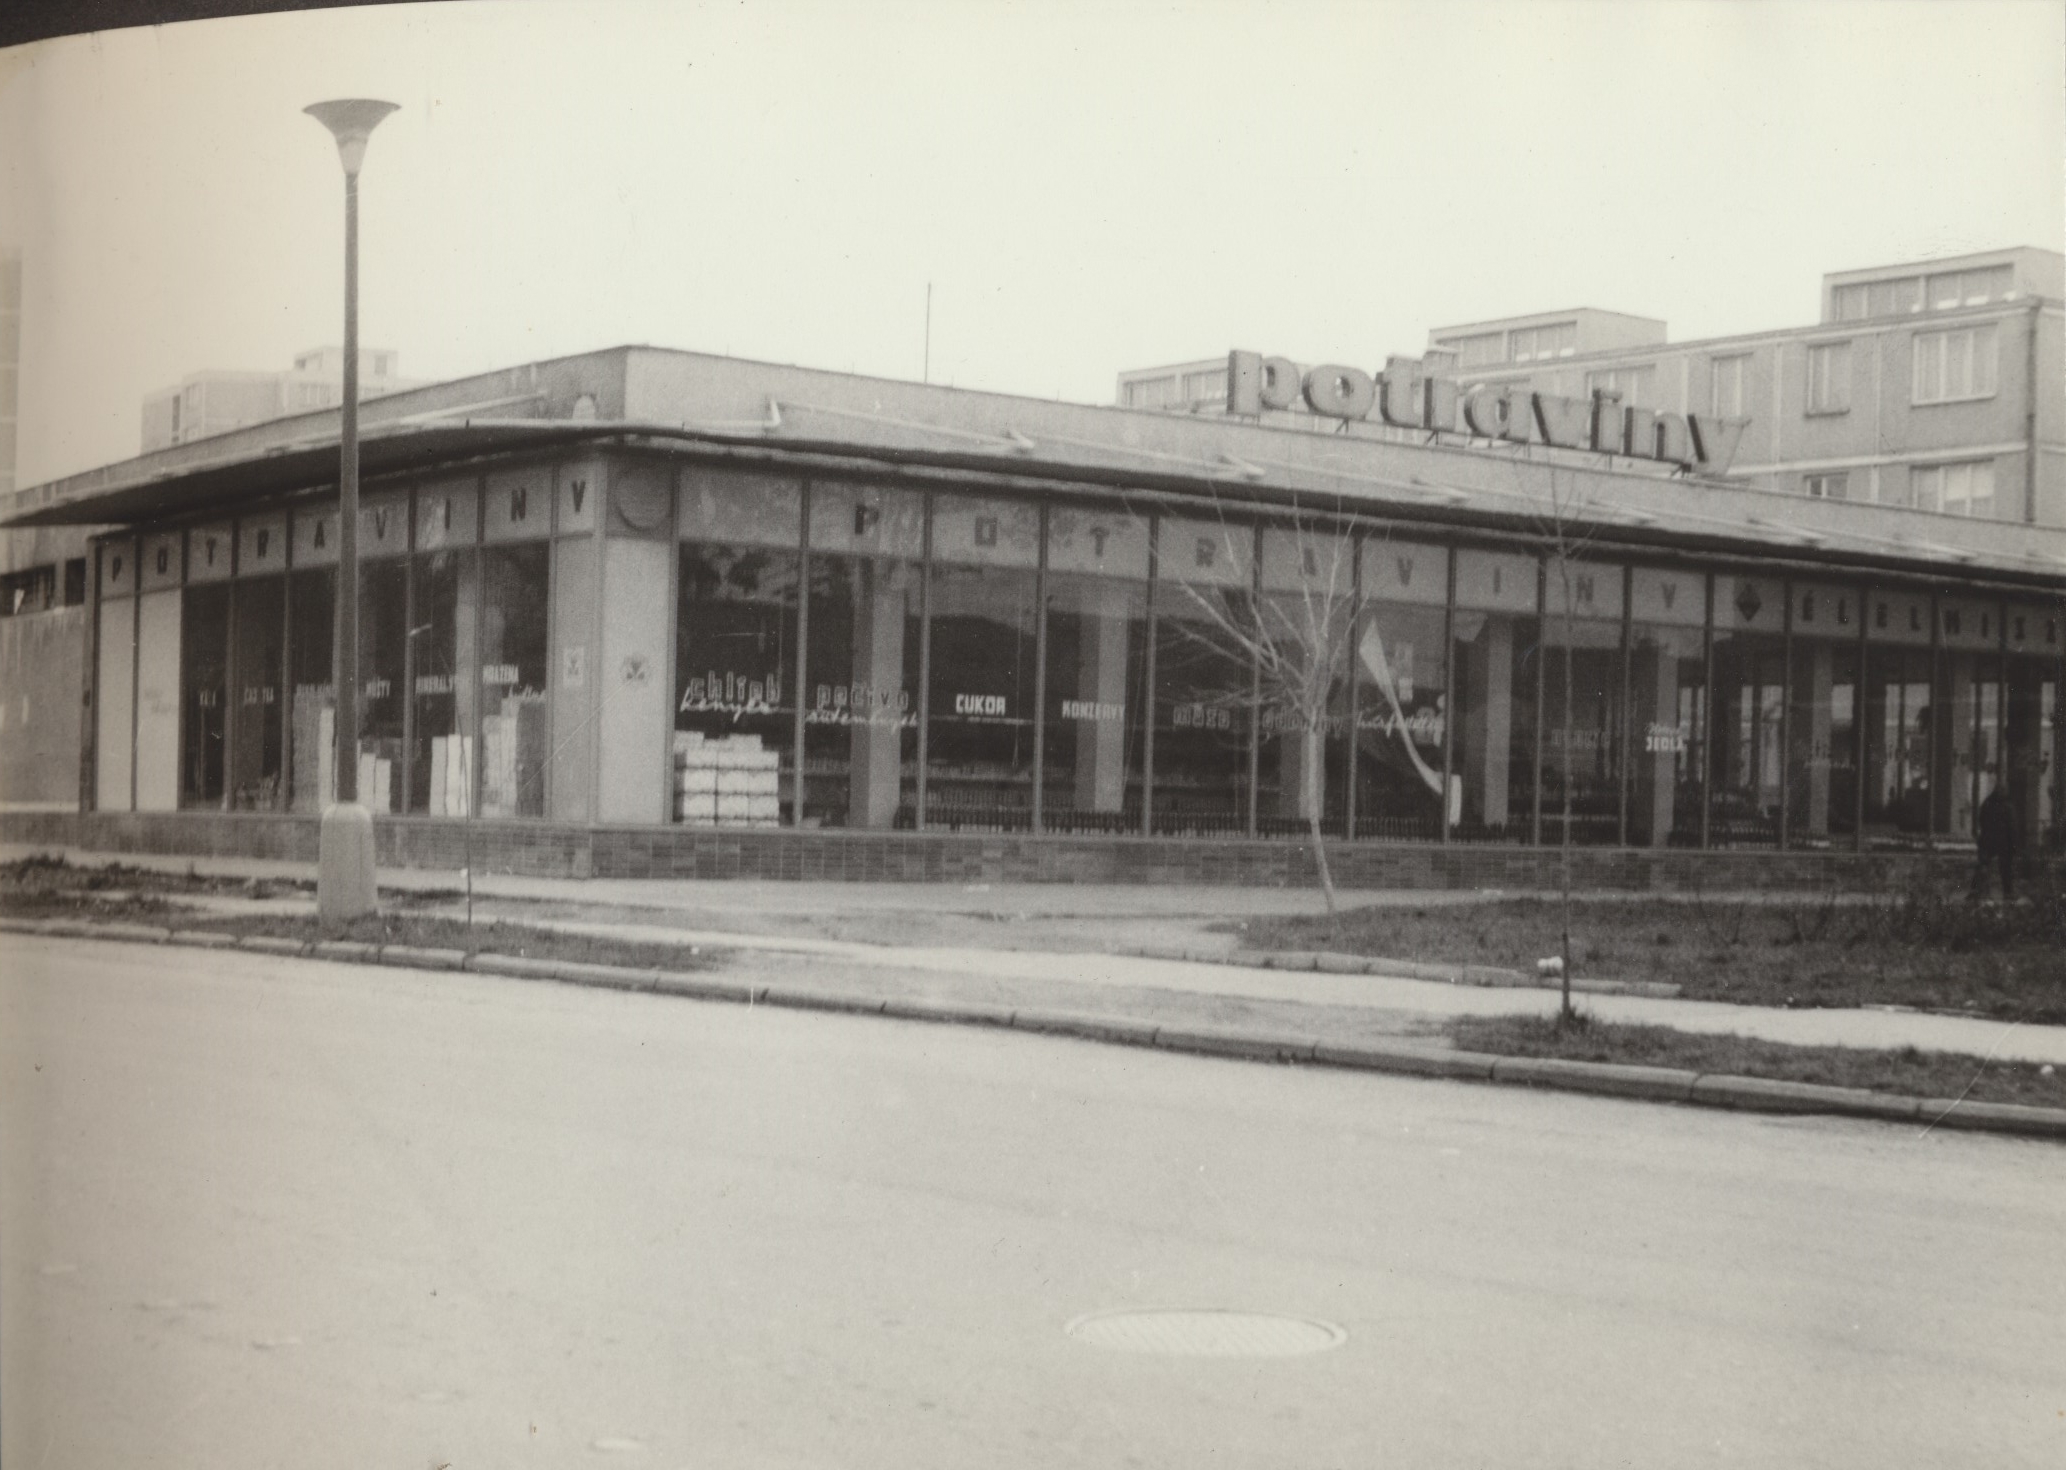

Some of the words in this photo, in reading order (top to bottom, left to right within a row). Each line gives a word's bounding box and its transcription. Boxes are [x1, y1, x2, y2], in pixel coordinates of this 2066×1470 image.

[1227, 348, 1752, 477] potraviny
[955, 693, 1006, 716] CUKOR
[1061, 699, 1126, 720] KONZERVY
